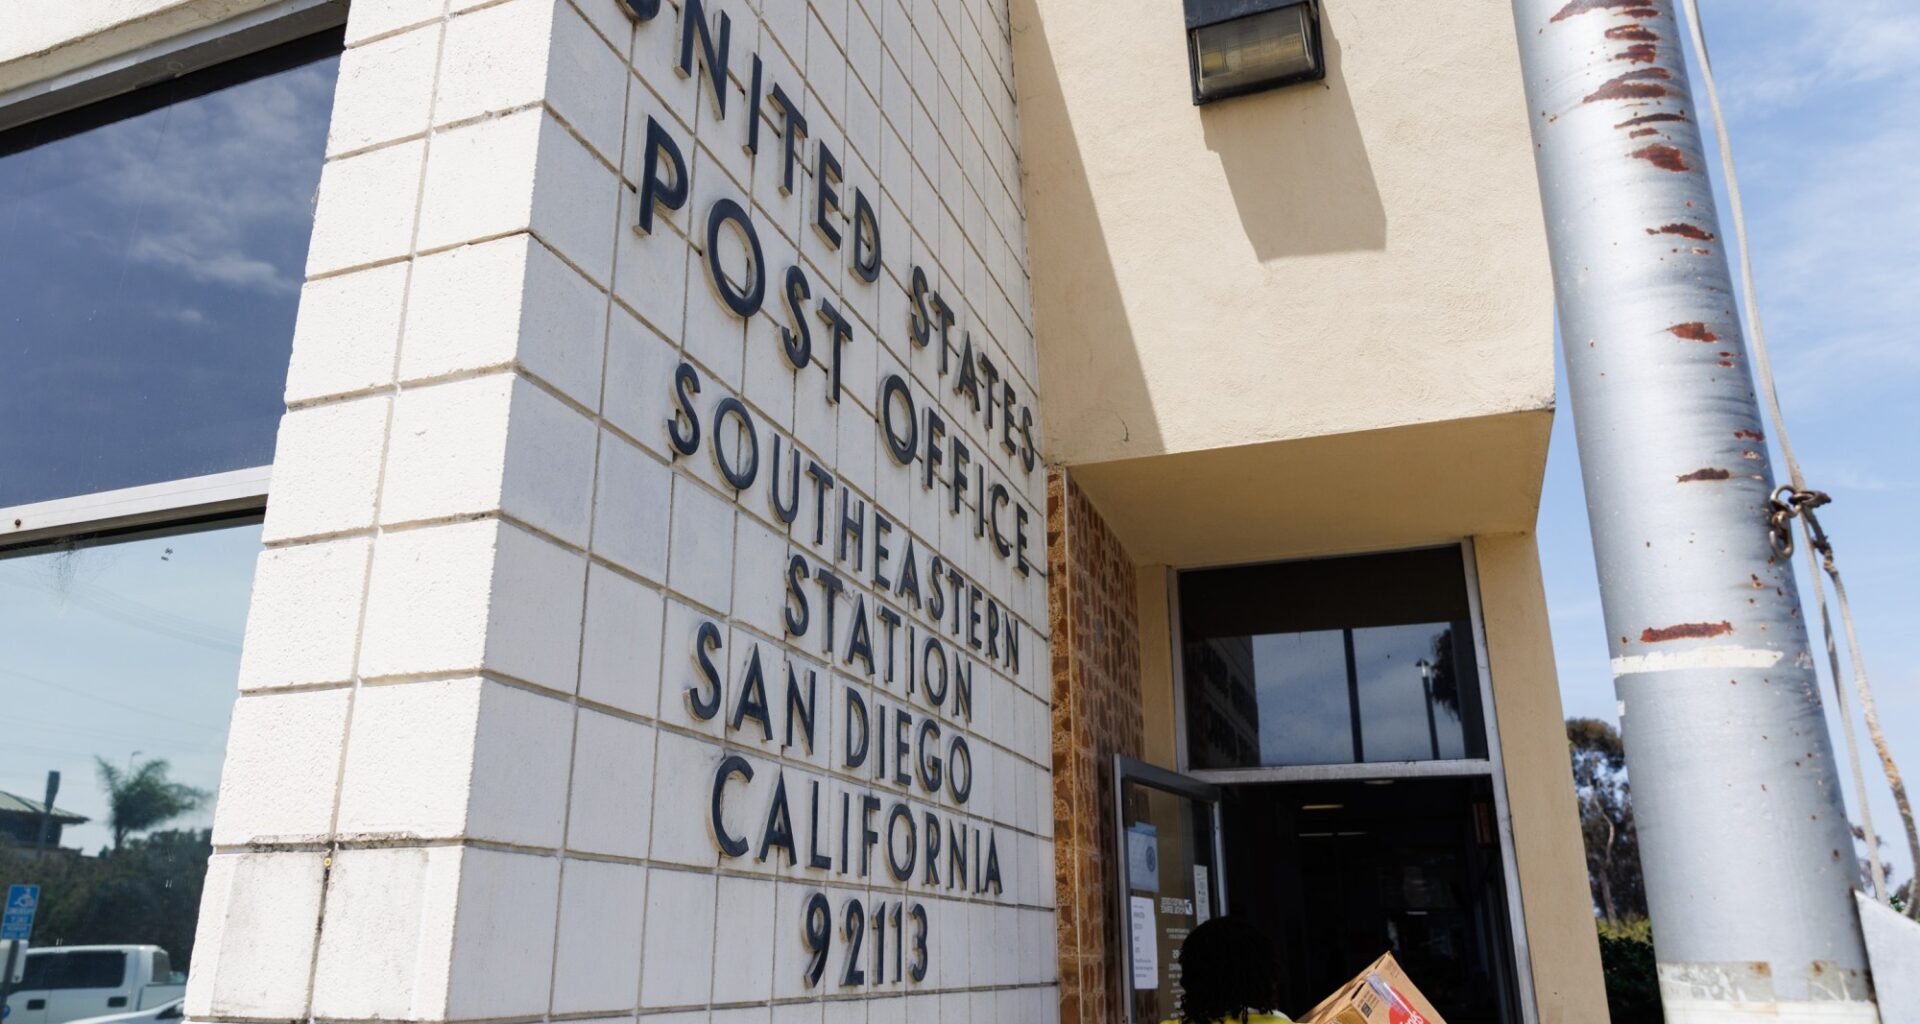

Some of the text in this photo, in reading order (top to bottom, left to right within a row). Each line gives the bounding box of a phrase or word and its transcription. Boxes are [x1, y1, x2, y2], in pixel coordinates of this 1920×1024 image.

[614, 0, 1035, 473] NITED STATES
[633, 114, 1030, 577] POST OFFICE
[666, 362, 1020, 675] SOUTHEASTERN
[684, 621, 973, 804] SAN DIEGO
[785, 554, 972, 723] STATION
[707, 755, 1003, 895] CALIFORNIA
[801, 892, 928, 989] 92113
